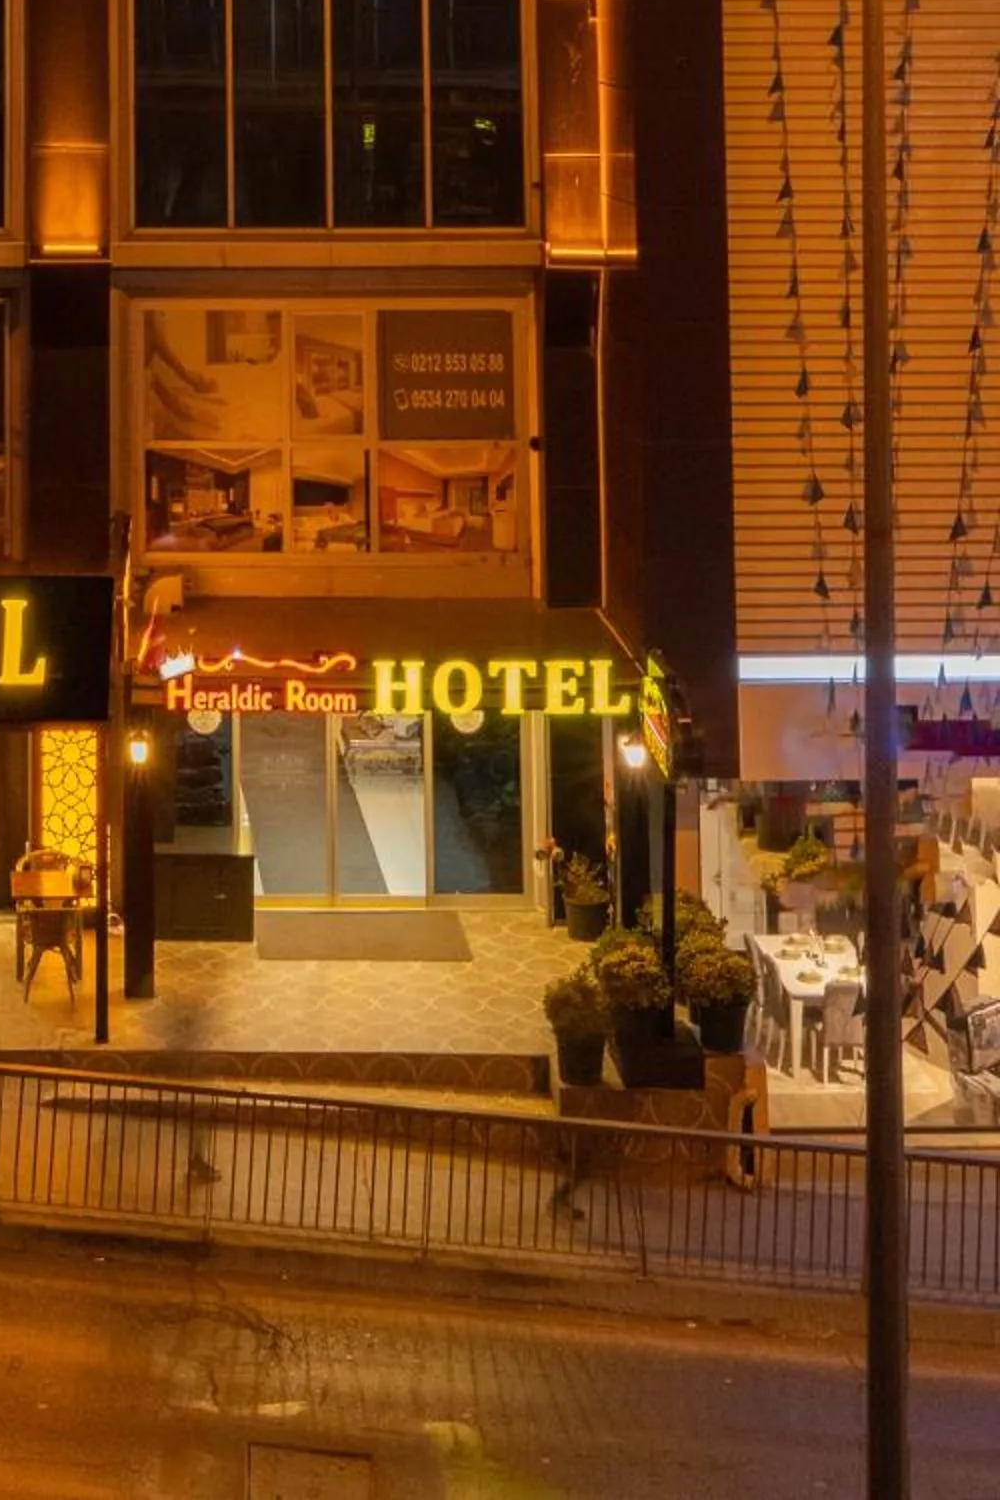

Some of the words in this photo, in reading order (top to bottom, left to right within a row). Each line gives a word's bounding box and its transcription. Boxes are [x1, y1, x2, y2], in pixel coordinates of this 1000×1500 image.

[167, 673, 273, 711] Heraldic
[285, 679, 357, 712] Room
[372, 660, 631, 715] HOTEL
